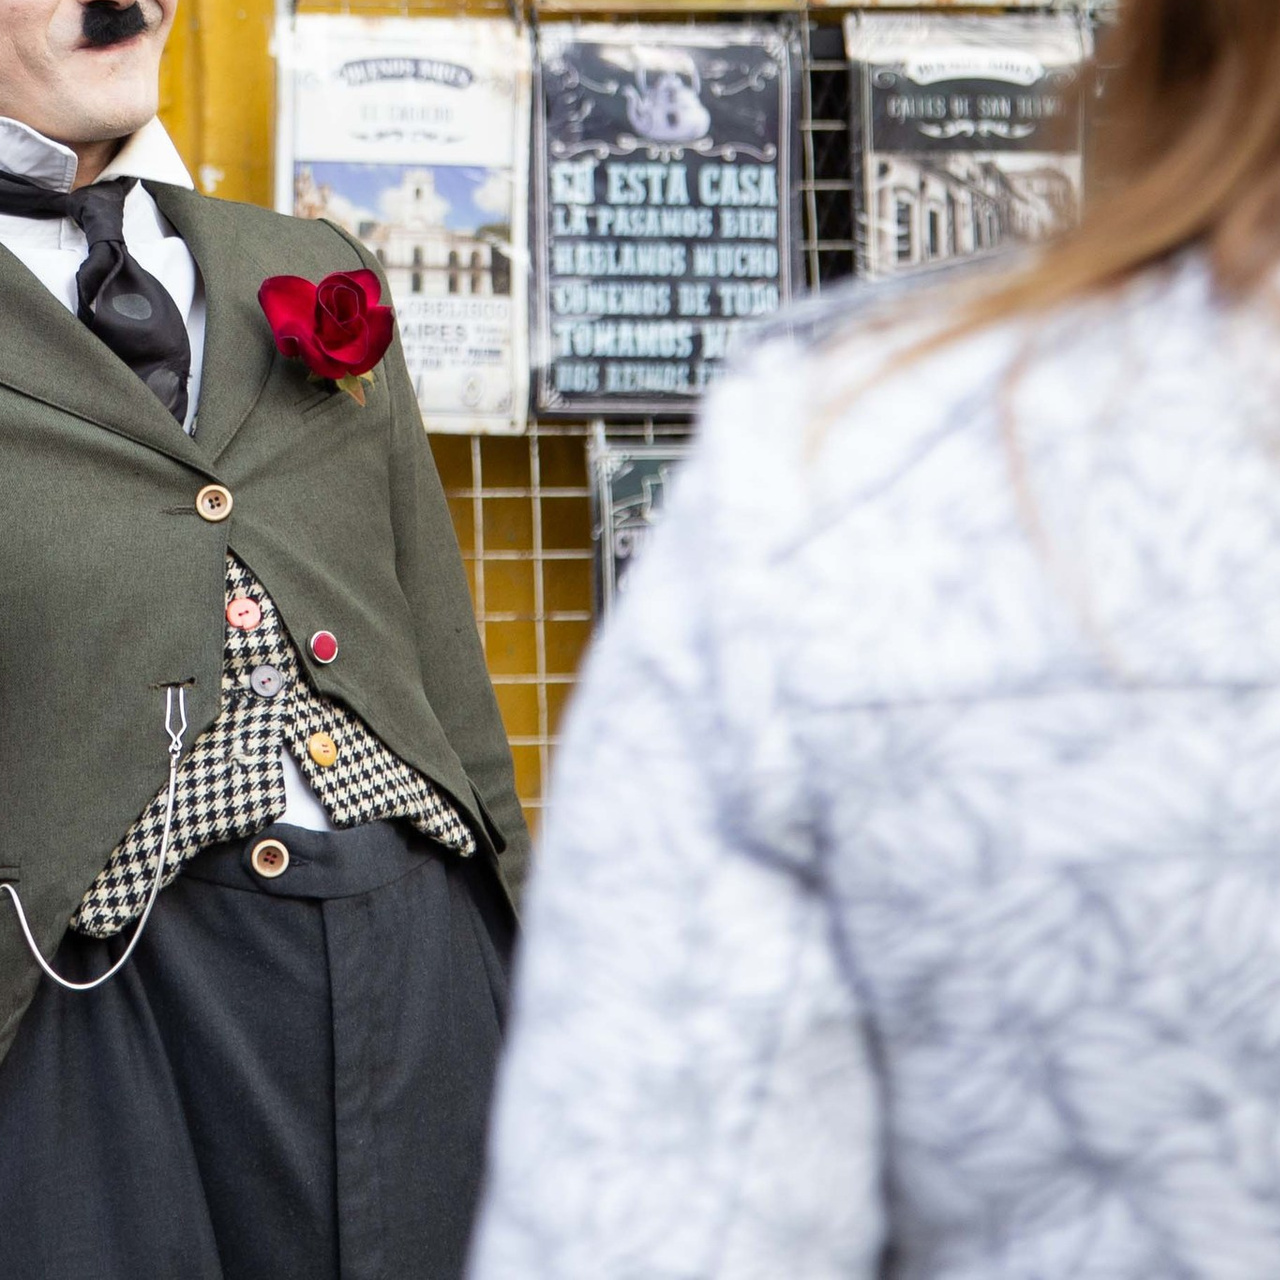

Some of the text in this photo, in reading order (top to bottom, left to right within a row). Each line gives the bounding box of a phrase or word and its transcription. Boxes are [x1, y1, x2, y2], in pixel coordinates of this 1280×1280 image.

[606, 163, 690, 206] ESTA
[698, 164, 778, 206] CASA
[552, 205, 777, 239] LA PASAMOS BIEN
[553, 241, 778, 278] HABLAMOS MUCHO
[553, 281, 671, 316] COMEMOS
[676, 282, 712, 316] DE
[552, 321, 694, 358] TOMAMOS
